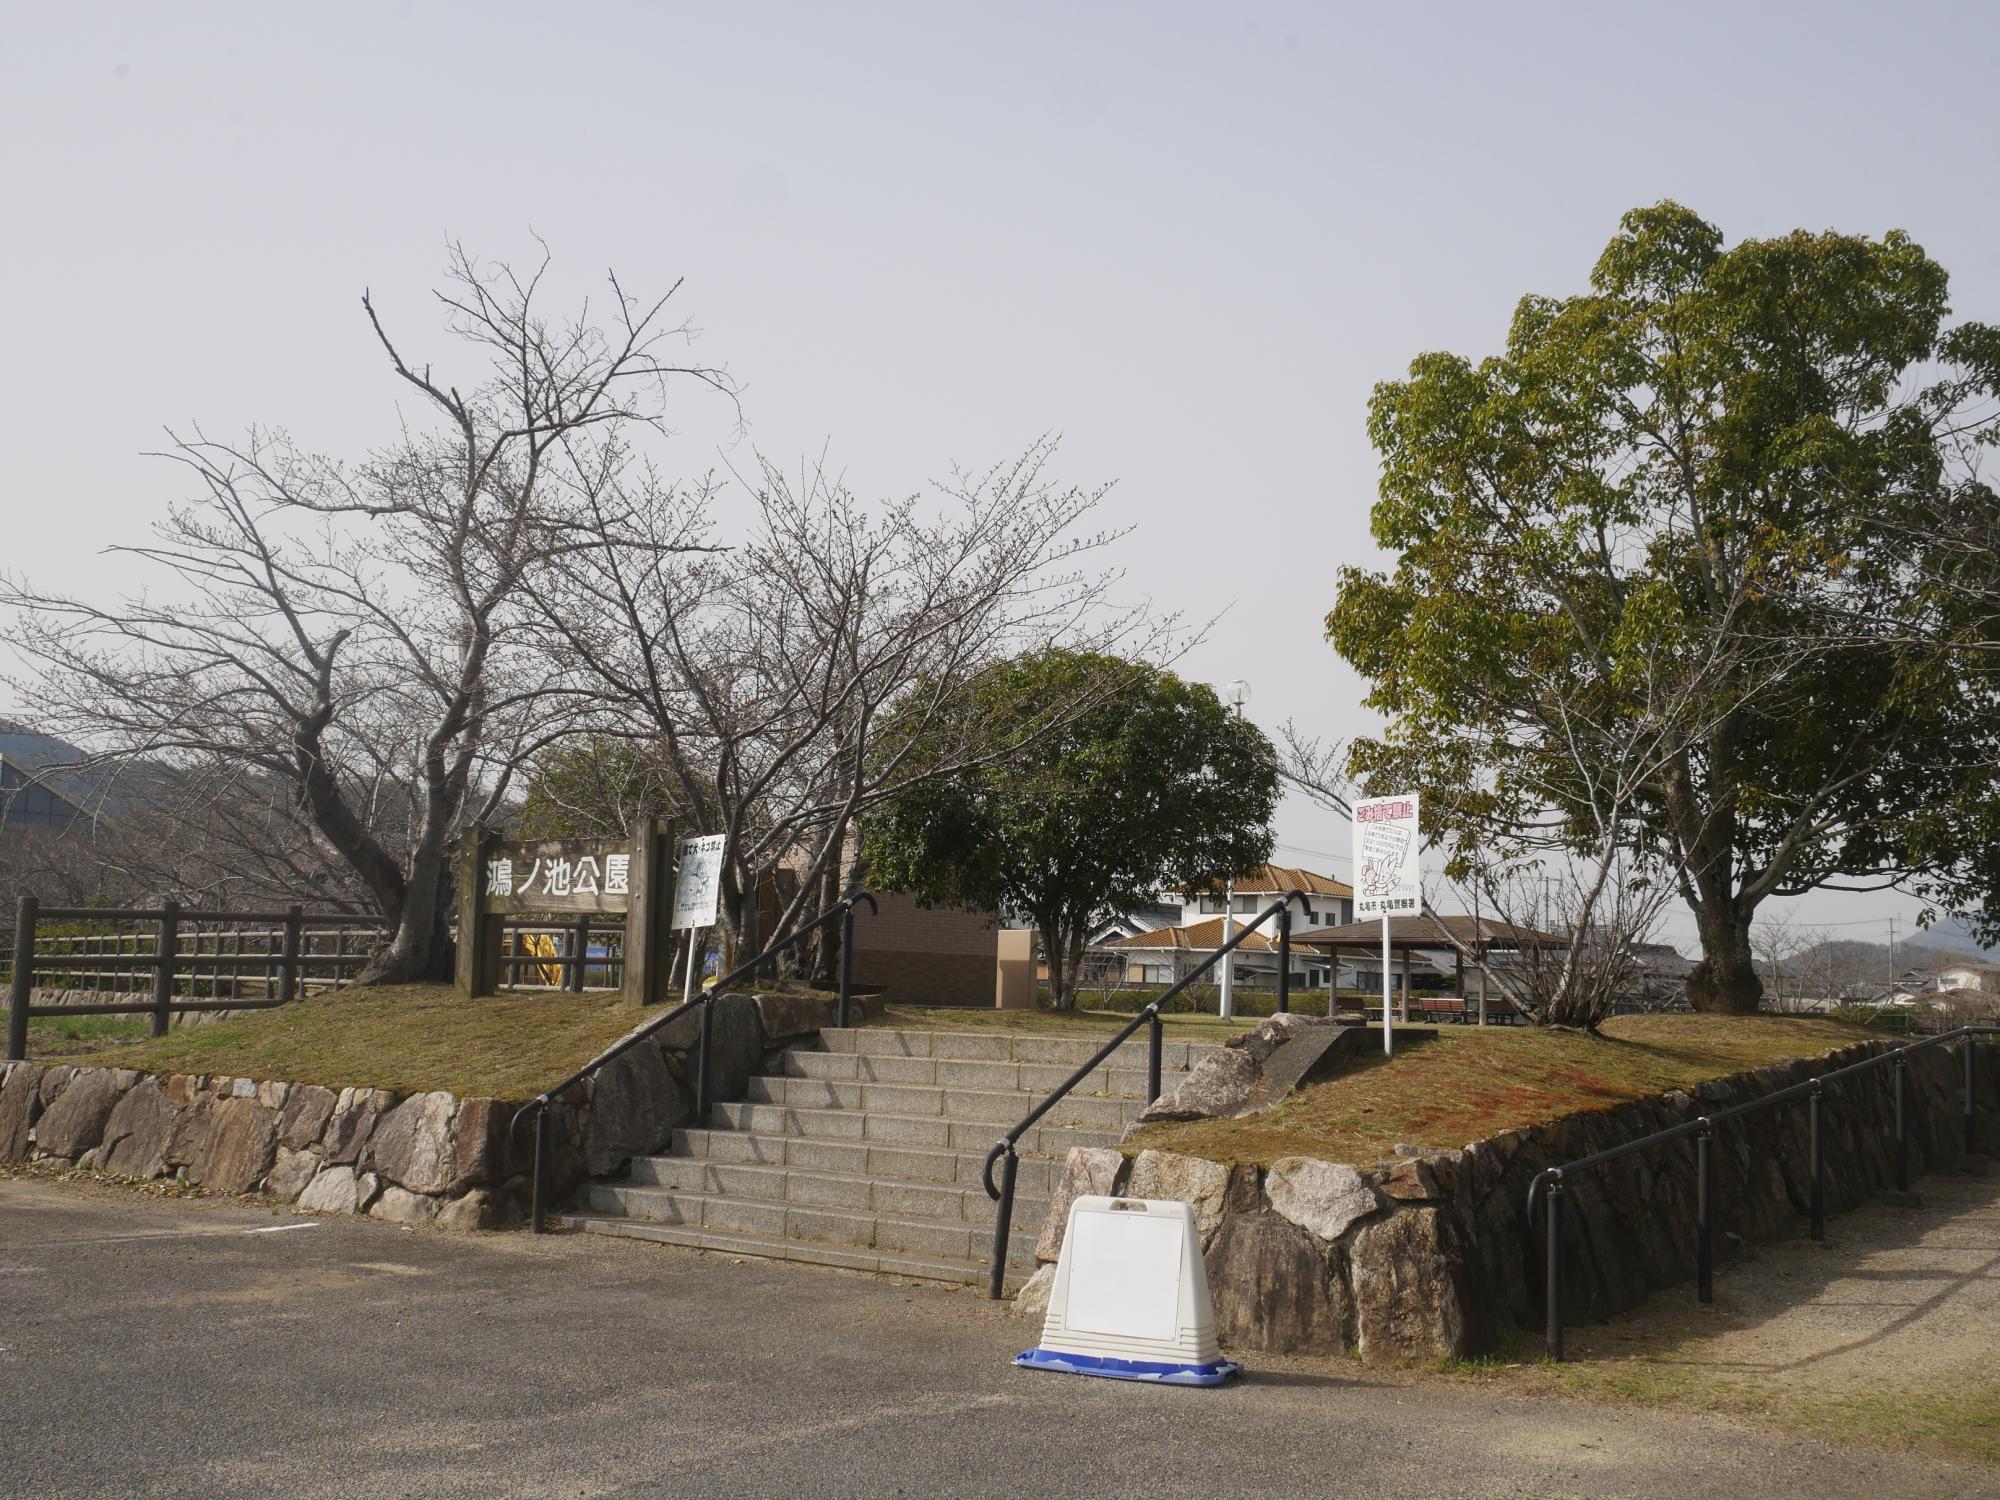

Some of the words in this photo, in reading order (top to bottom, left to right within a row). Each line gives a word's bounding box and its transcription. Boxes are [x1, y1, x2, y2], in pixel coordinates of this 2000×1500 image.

[1357, 801, 1413, 823] ごみ捨て禁止
[486, 854, 630, 896] 鴻ノ池公園
